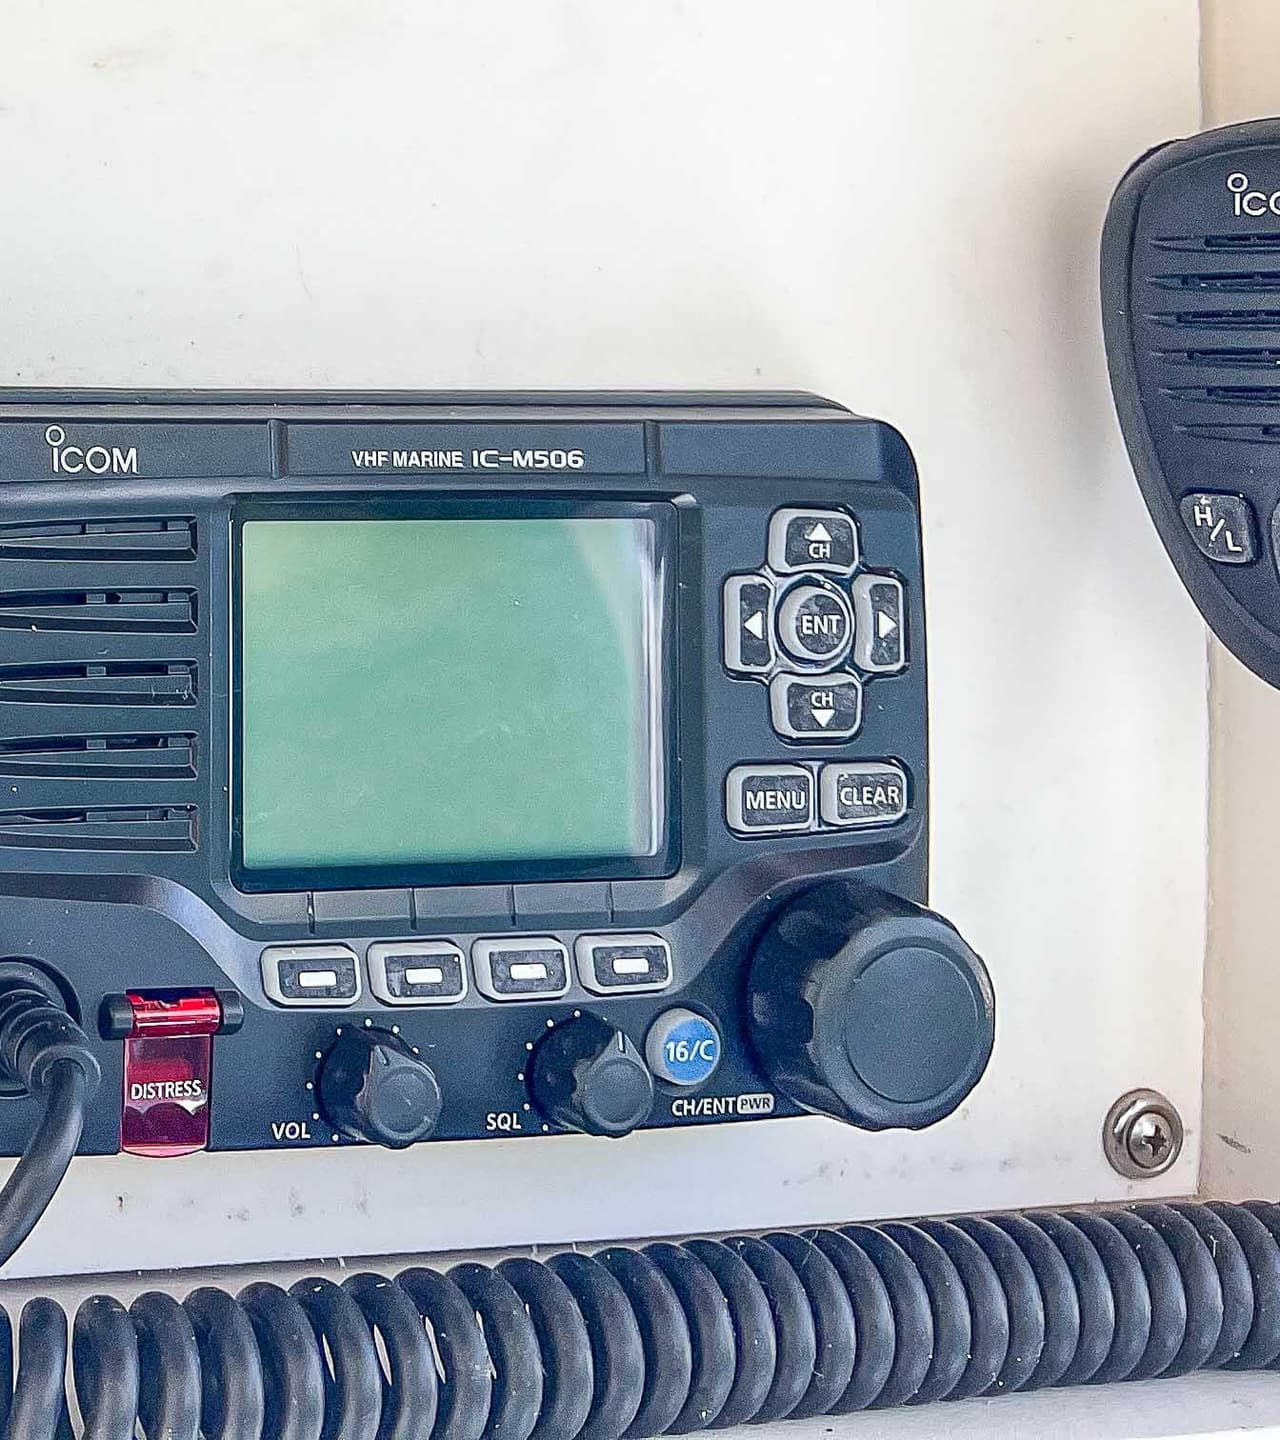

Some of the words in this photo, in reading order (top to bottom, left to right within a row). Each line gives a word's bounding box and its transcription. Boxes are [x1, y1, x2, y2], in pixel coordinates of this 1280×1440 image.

[351, 449, 389, 469] VHF
[392, 449, 464, 469] MARINE
[471, 448, 585, 469] IC-M506
[808, 542, 831, 558] CH
[801, 615, 841, 635] ENT
[811, 691, 834, 707] CH
[745, 790, 806, 810] MENU
[839, 786, 901, 806] CLEAR
[666, 1039, 714, 1063] 16/C
[131, 1079, 202, 1100] DISTRESS
[672, 1098, 736, 1117] CH/ENT
[740, 1095, 771, 1110] PWR
[271, 1122, 311, 1140] VOL
[486, 1111, 522, 1131] SQL
